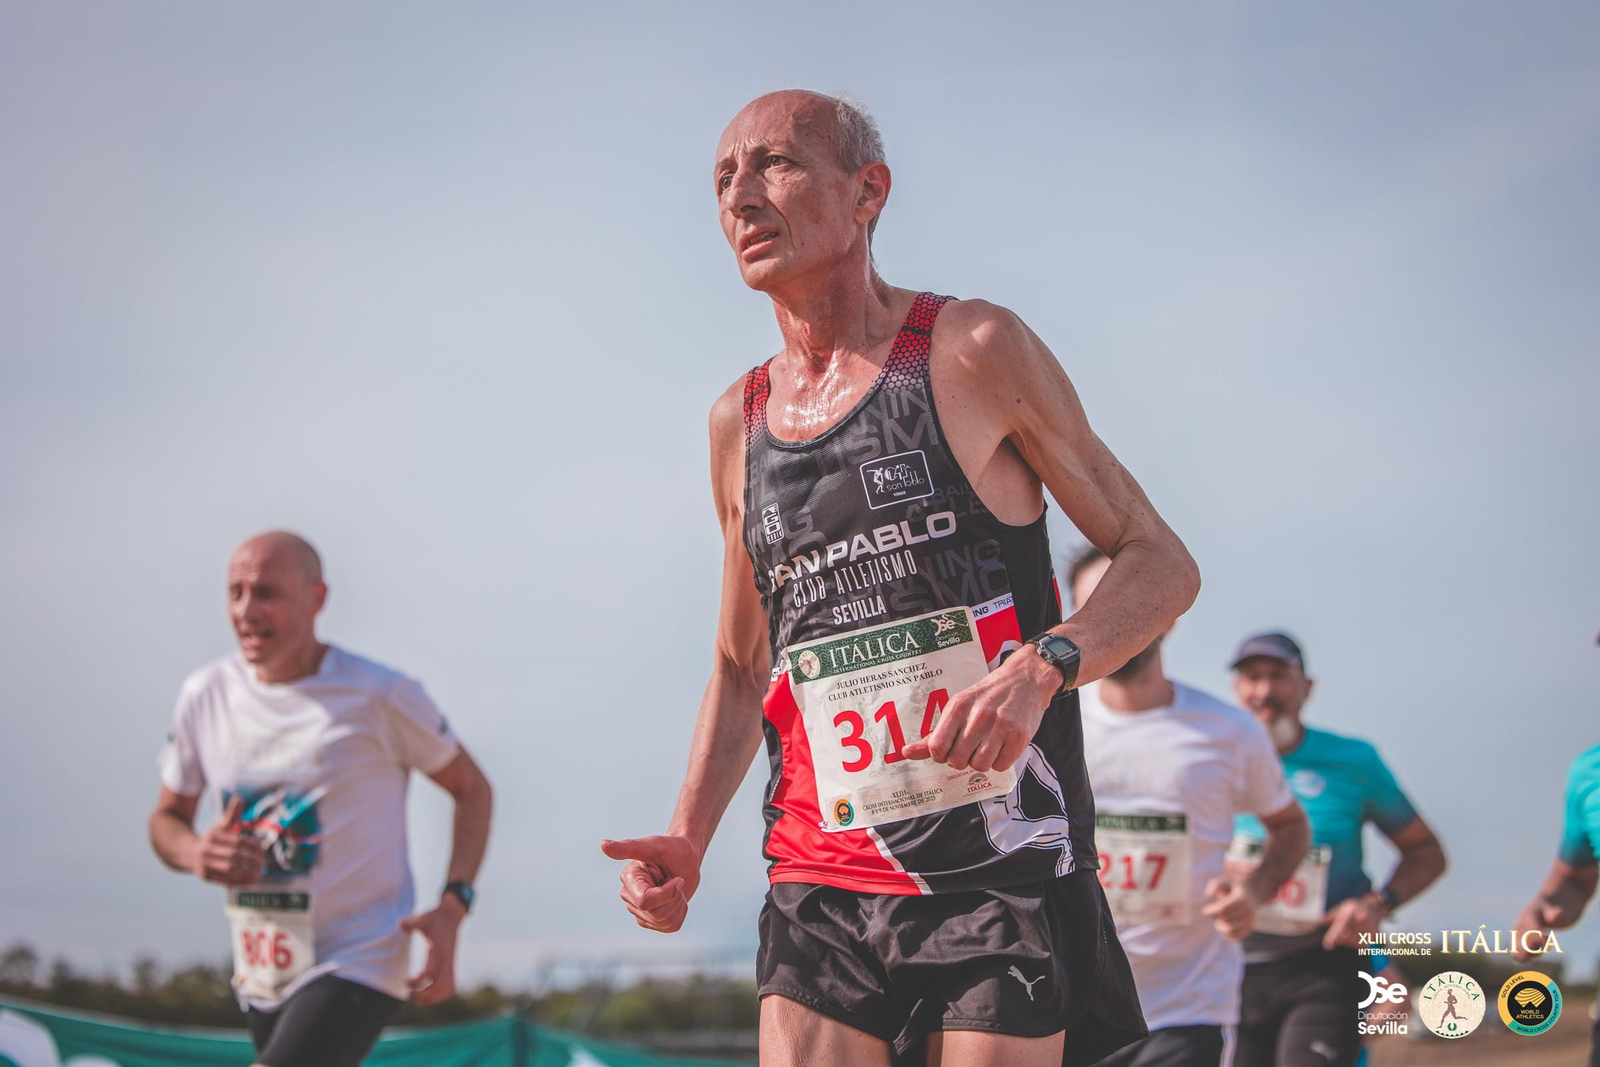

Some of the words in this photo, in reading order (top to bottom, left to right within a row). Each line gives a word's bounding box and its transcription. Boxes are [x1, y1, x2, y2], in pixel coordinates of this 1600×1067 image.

[825, 511, 957, 568] PABLO
[793, 575, 826, 608] CLUB
[833, 549, 918, 596] ATLETISMO
[832, 595, 887, 626] SEVILLA
[829, 630, 921, 669] ITÁLICA
[828, 691, 849, 702] CLUB
[849, 680, 895, 697] ATLETISMO
[896, 676, 913, 687] SAN
[914, 668, 943, 682] PABLO
[835, 679, 859, 690] JULIO
[859, 673, 888, 685] HERAS
[887, 662, 928, 678] SANCHEZ
